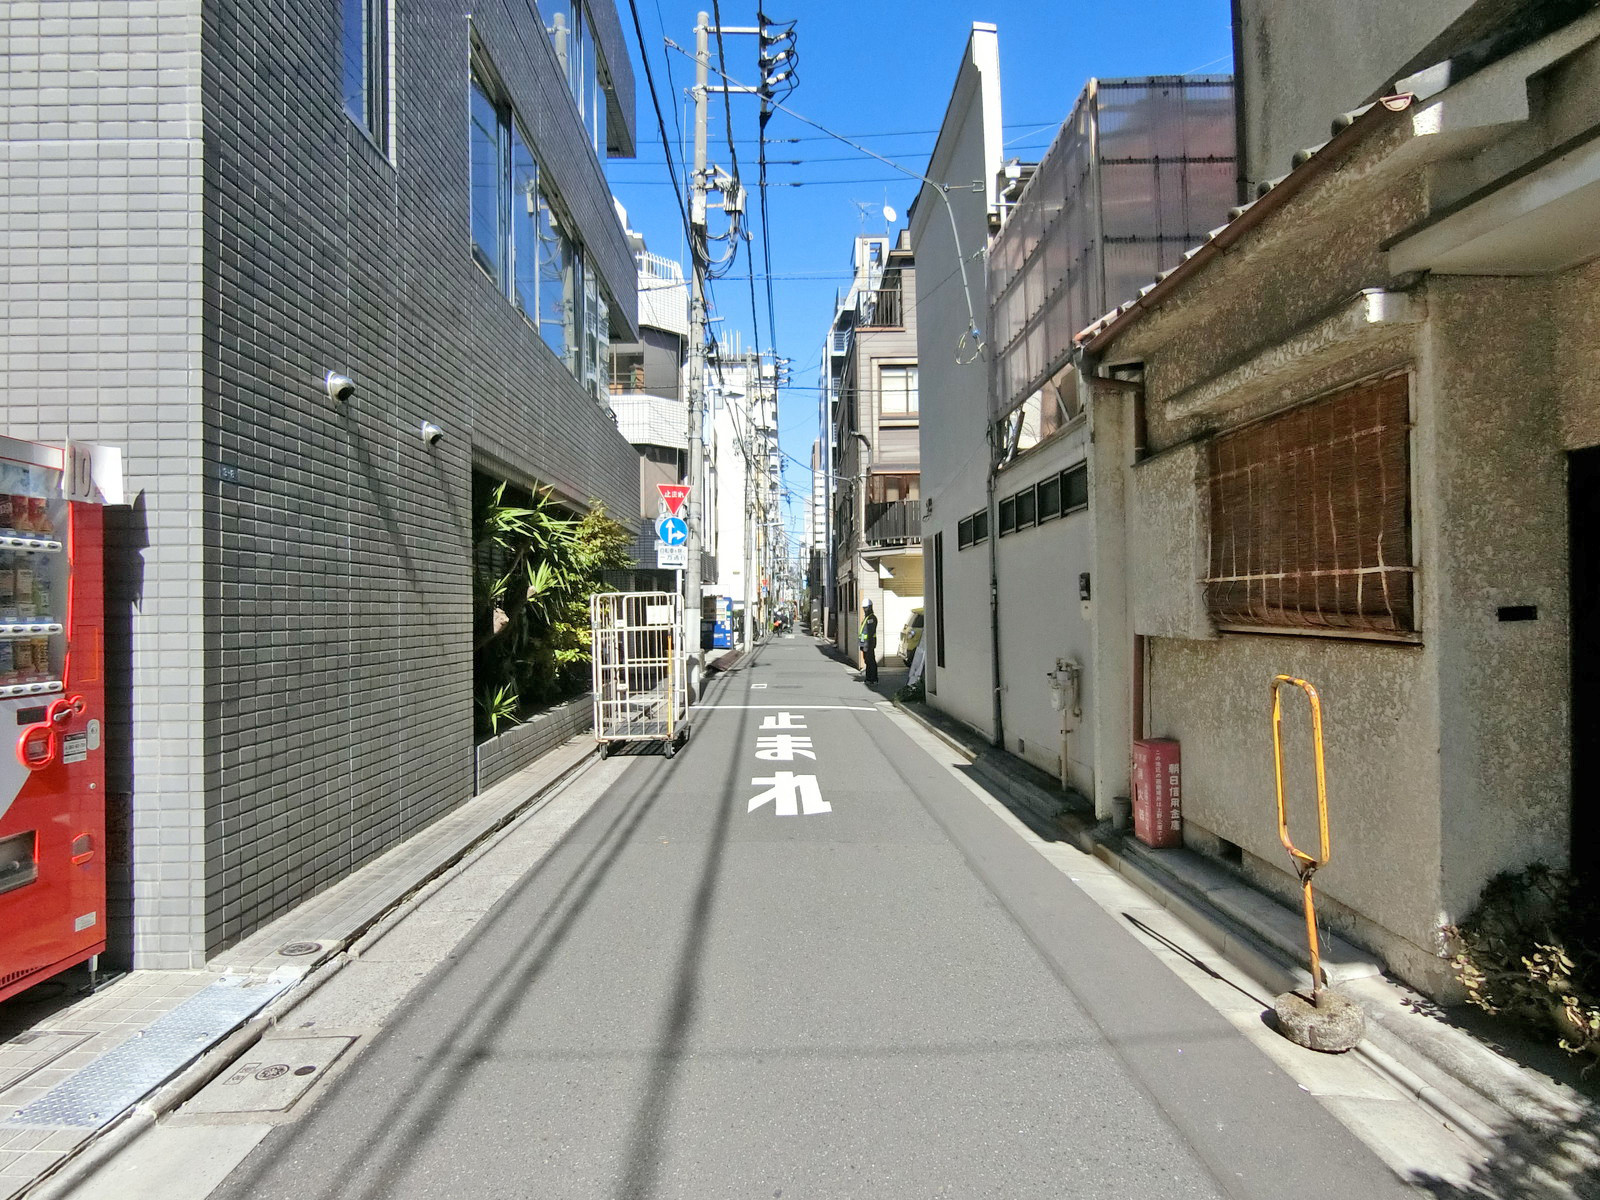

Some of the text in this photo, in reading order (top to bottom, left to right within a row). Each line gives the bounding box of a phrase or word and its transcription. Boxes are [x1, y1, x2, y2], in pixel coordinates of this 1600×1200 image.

[664, 490, 685, 498] 止まれ
[747, 711, 833, 816] 止まれ
[1168, 763, 1180, 831] 朝日信用金庫
